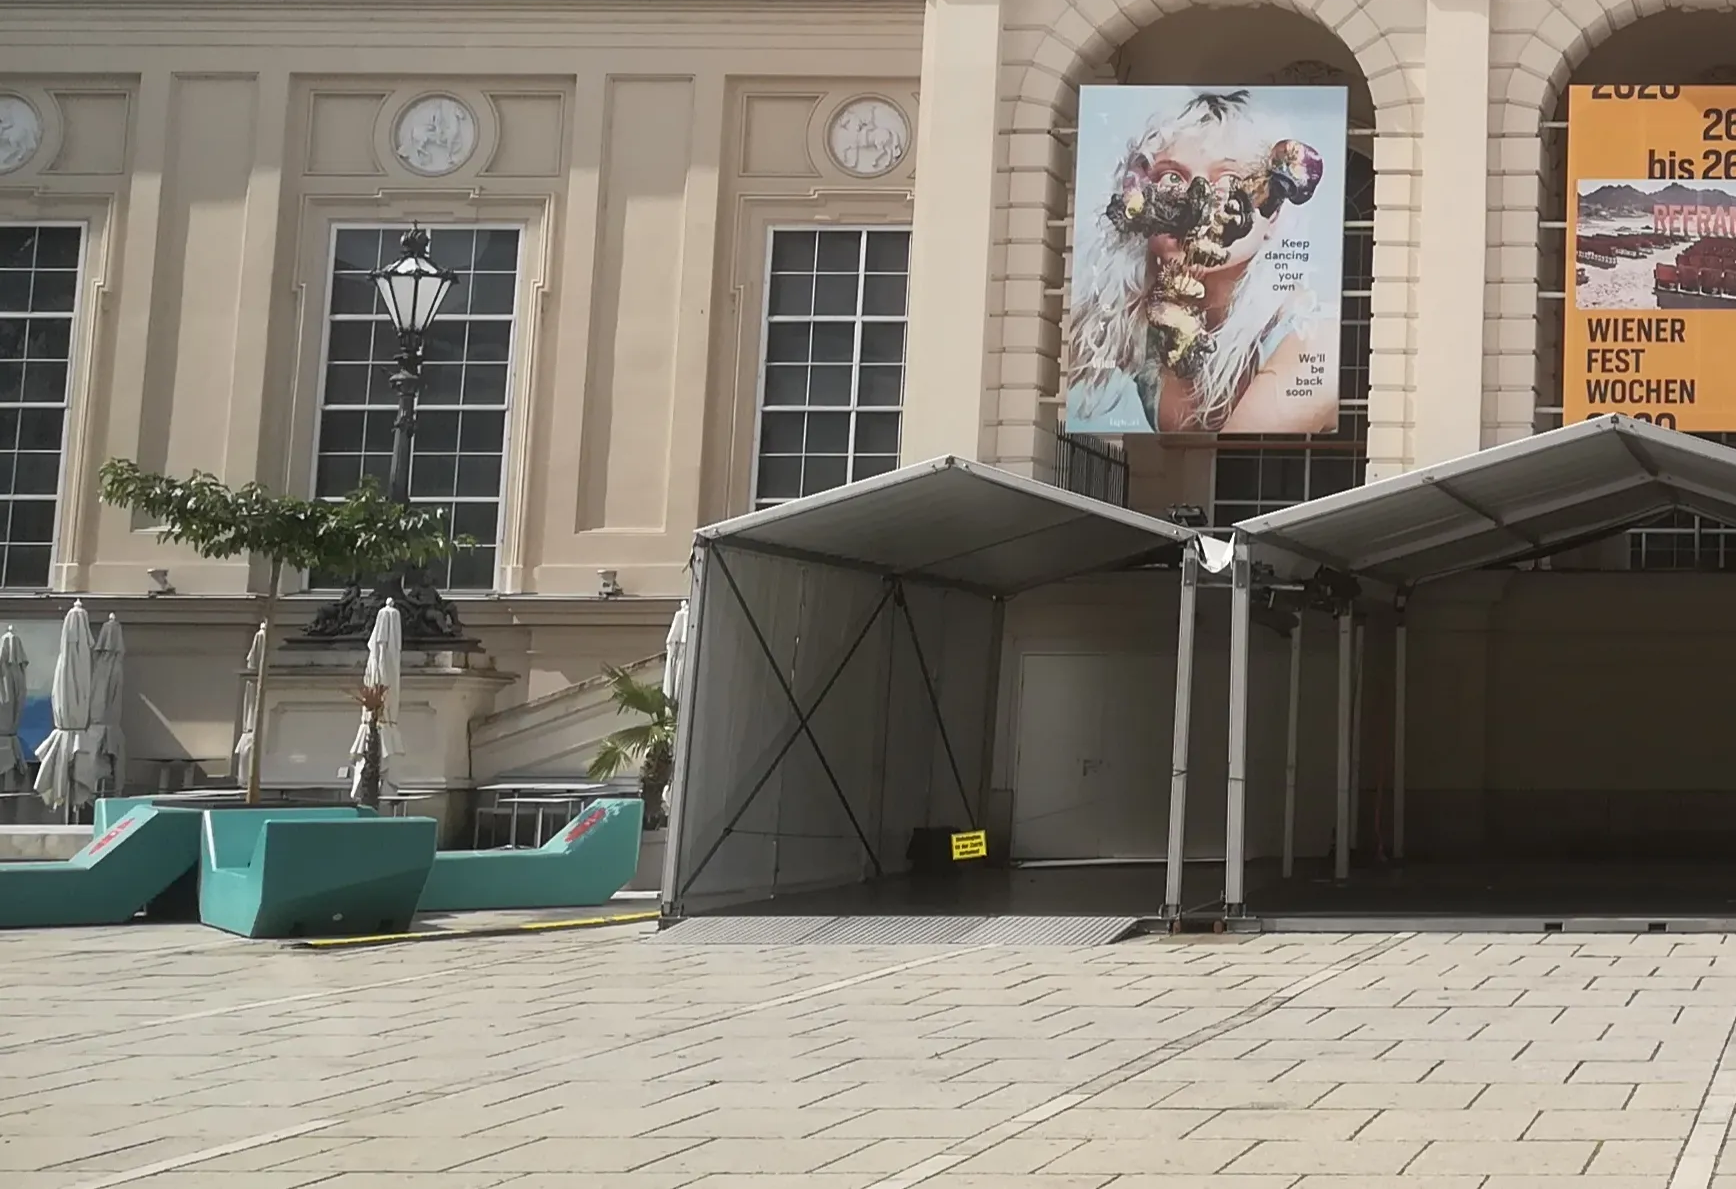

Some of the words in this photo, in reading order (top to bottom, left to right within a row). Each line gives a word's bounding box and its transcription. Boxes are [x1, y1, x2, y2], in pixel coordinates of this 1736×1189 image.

[1648, 149, 1694, 179] bis
[1282, 239, 1310, 249] Keep
[1265, 251, 1308, 261] dancing
[1278, 273, 1303, 282] your
[1272, 283, 1295, 291] own
[1587, 318, 1686, 342] WIENER
[1586, 349, 1645, 373] FEST
[1311, 365, 1324, 373] be
[1296, 377, 1323, 385] back
[1586, 379, 1695, 404] WOCHEN
